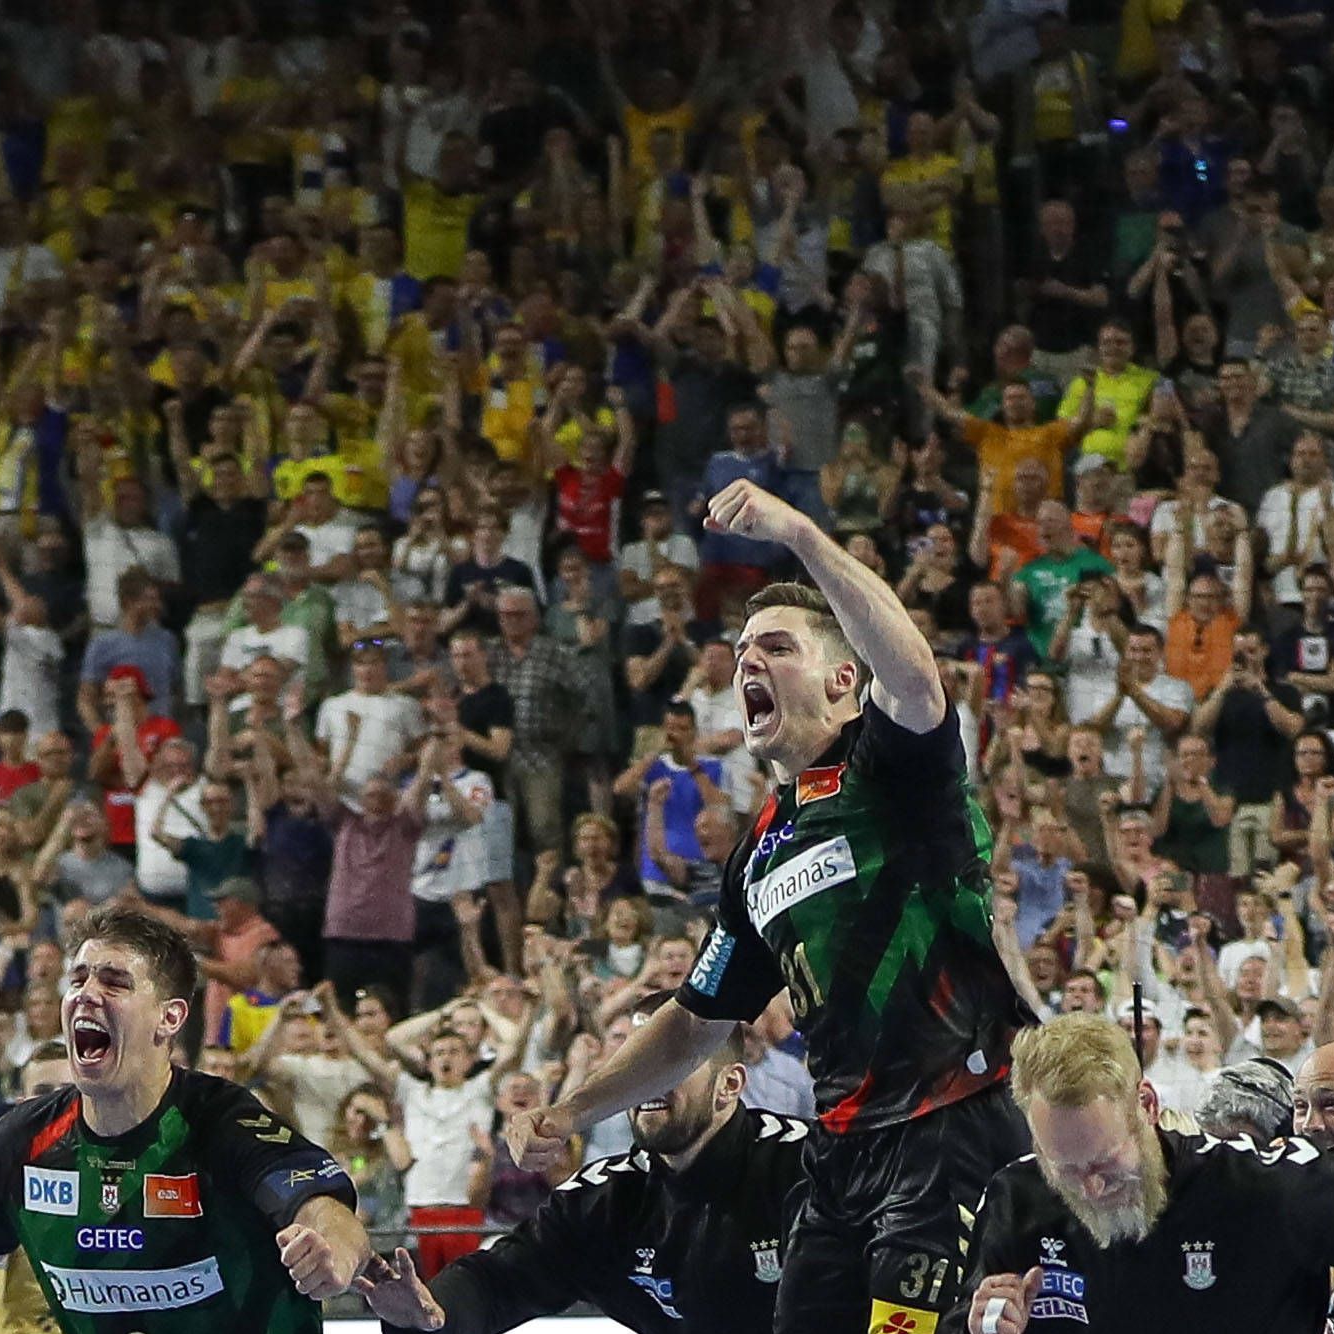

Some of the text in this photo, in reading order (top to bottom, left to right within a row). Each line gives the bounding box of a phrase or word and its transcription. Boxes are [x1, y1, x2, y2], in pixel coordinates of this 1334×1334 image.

[781, 942, 824, 1018] 31
[29, 1177, 73, 1205] DKB
[77, 1228, 143, 1249] GETEC
[69, 1275, 206, 1305] Humanas
[899, 1253, 949, 1302] 31
[1041, 1273, 1084, 1297] ETEC
